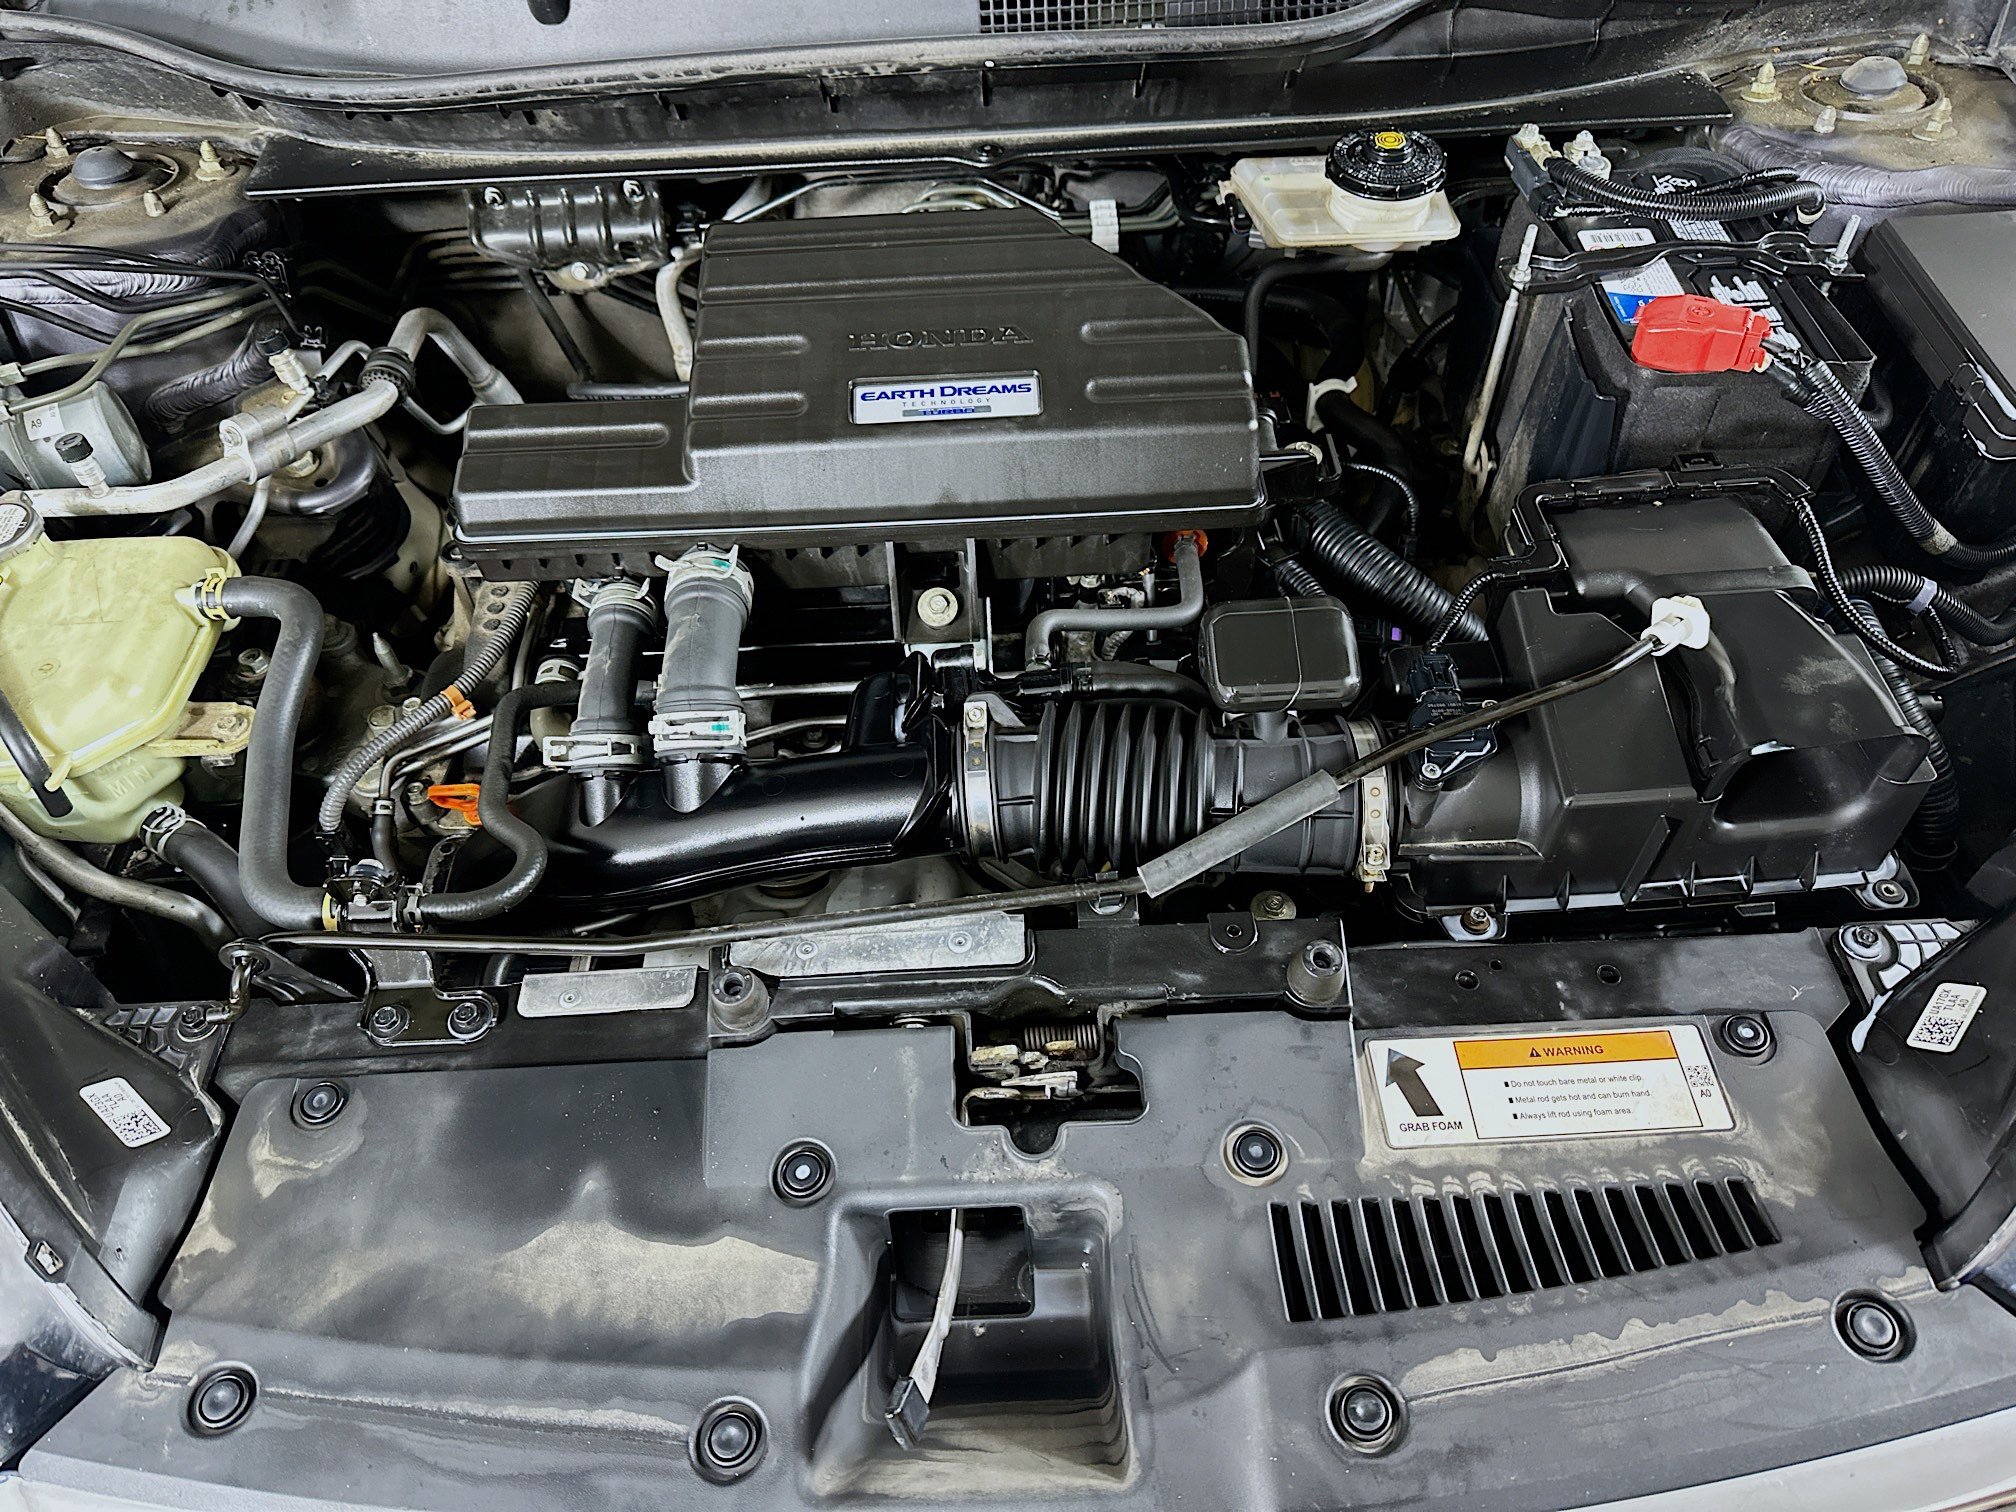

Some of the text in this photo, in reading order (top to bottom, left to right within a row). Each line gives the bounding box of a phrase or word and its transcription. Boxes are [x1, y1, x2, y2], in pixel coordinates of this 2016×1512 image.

[848, 324, 1034, 351] HONDA
[860, 383, 1032, 401] EARTH DREAMS
[902, 398, 990, 407] TECHNOLOGY
[106, 764, 154, 799] MIN
[1543, 1044, 1604, 1058] WARNING
[1510, 1080, 1522, 1088] Do
[1523, 1079, 1535, 1087] not
[1536, 1078, 1557, 1087] touch
[1557, 1077, 1576, 1086] bare
[1576, 1075, 1598, 1085] metal
[1608, 1074, 1628, 1083] white
[1515, 1096, 1536, 1104] Metal
[1537, 1095, 1549, 1103] rod
[1551, 1094, 1568, 1104] gets
[1568, 1093, 1581, 1102] hot
[1582, 1092, 1596, 1100] and
[1597, 1092, 1612, 1100] can
[1613, 1090, 1630, 1099] burn
[1520, 1111, 1546, 1121] Always
[1547, 1110, 1557, 1119] lift
[1558, 1110, 1571, 1118] rod
[1572, 1108, 1593, 1119] using
[1593, 1107, 1613, 1116] foam
[1399, 1120, 1464, 1133] GRAB FOAM
